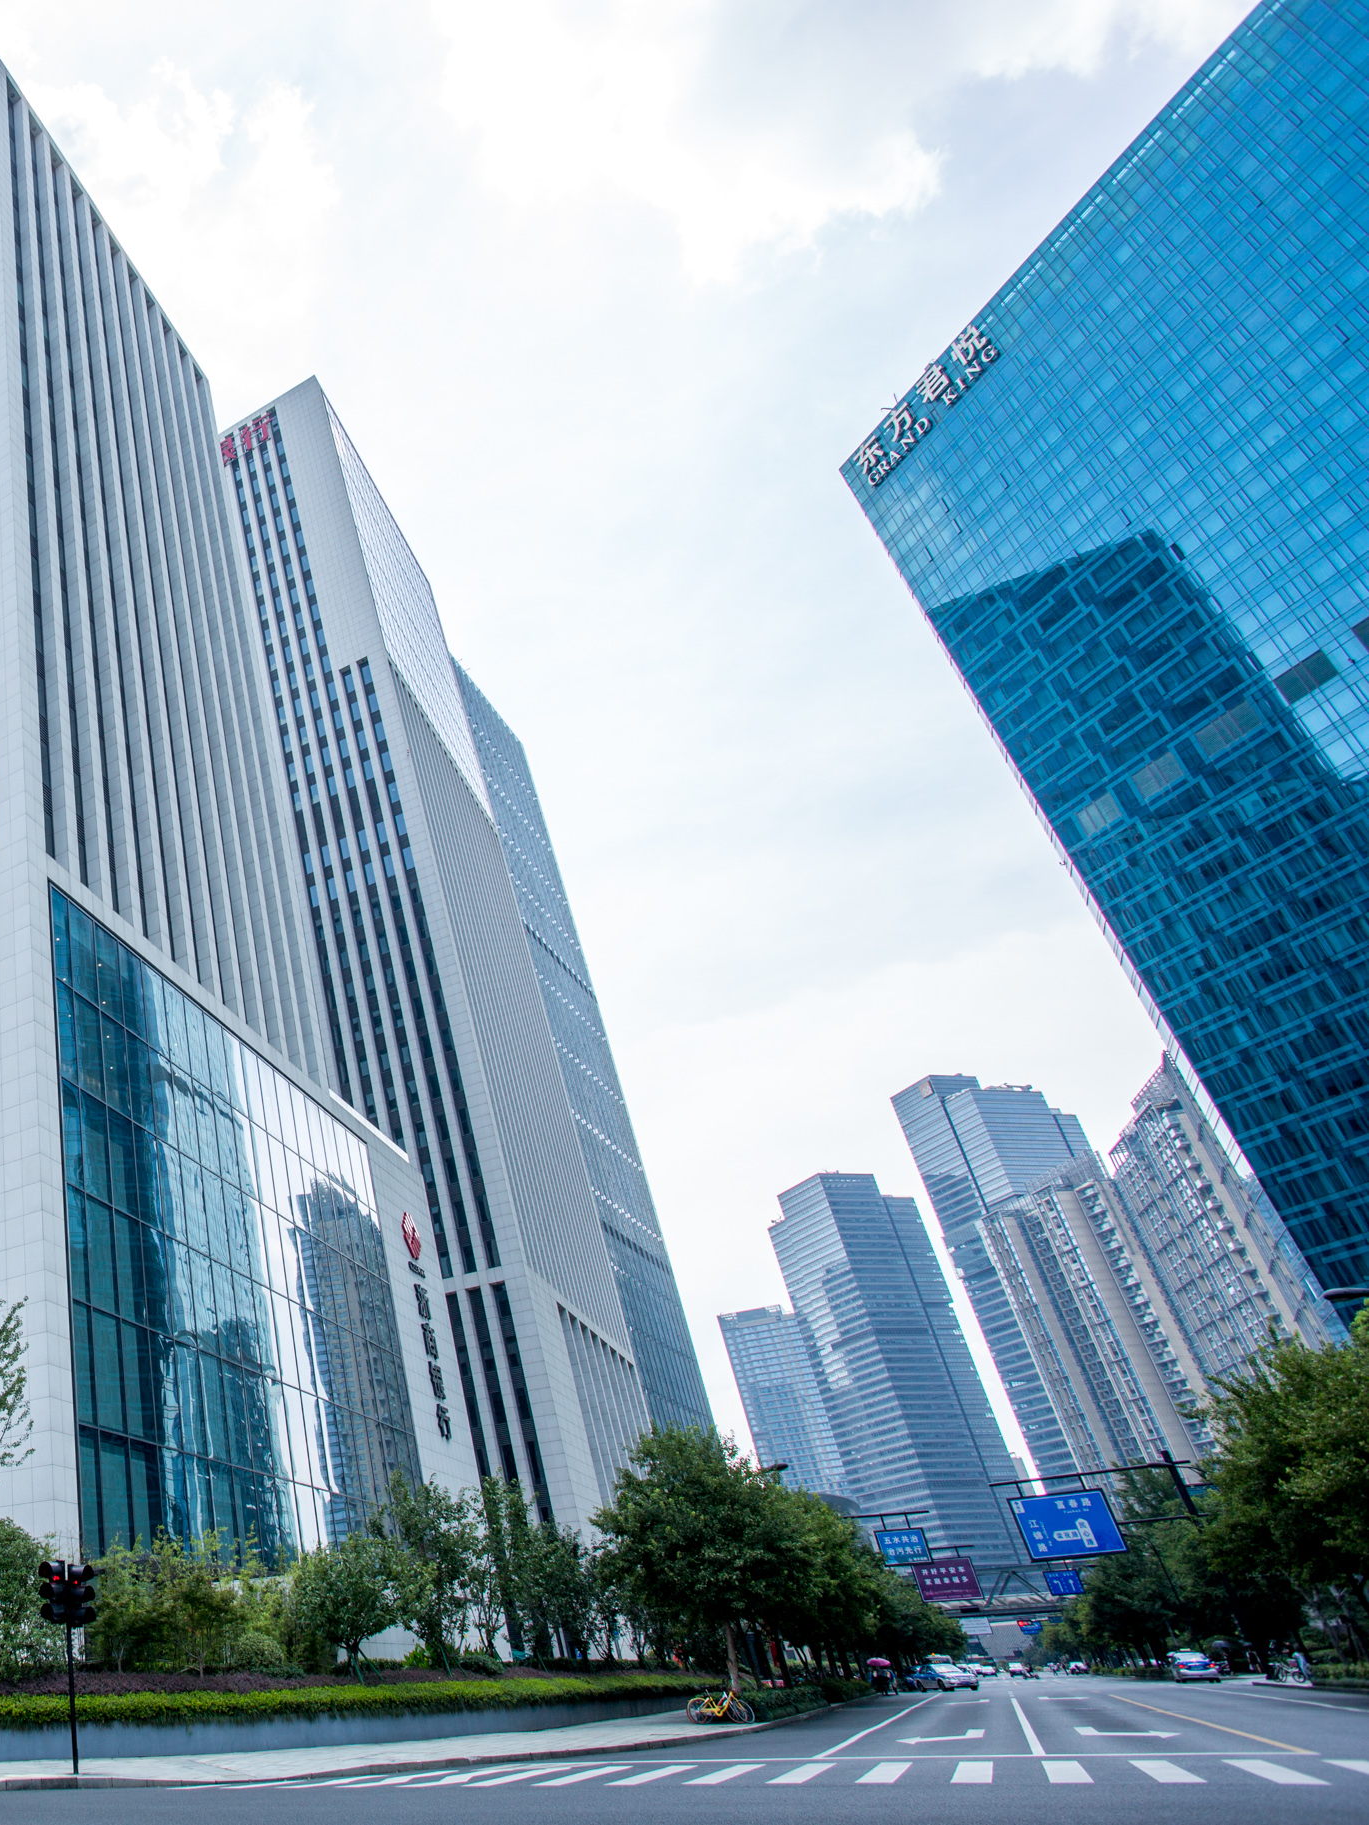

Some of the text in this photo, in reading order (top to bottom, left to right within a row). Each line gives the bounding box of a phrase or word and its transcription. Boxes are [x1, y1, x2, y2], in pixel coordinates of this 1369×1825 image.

[852, 325, 987, 475] 东方君悦
[867, 345, 998, 487] GRAND KING
[413, 1283, 453, 1441] 浙商银行
[1054, 1497, 1092, 1510] 富春路
[883, 1534, 919, 1545] 五水共治
[887, 1545, 922, 1556] 治污先行
[921, 1566, 966, 1576] 开好平安车
